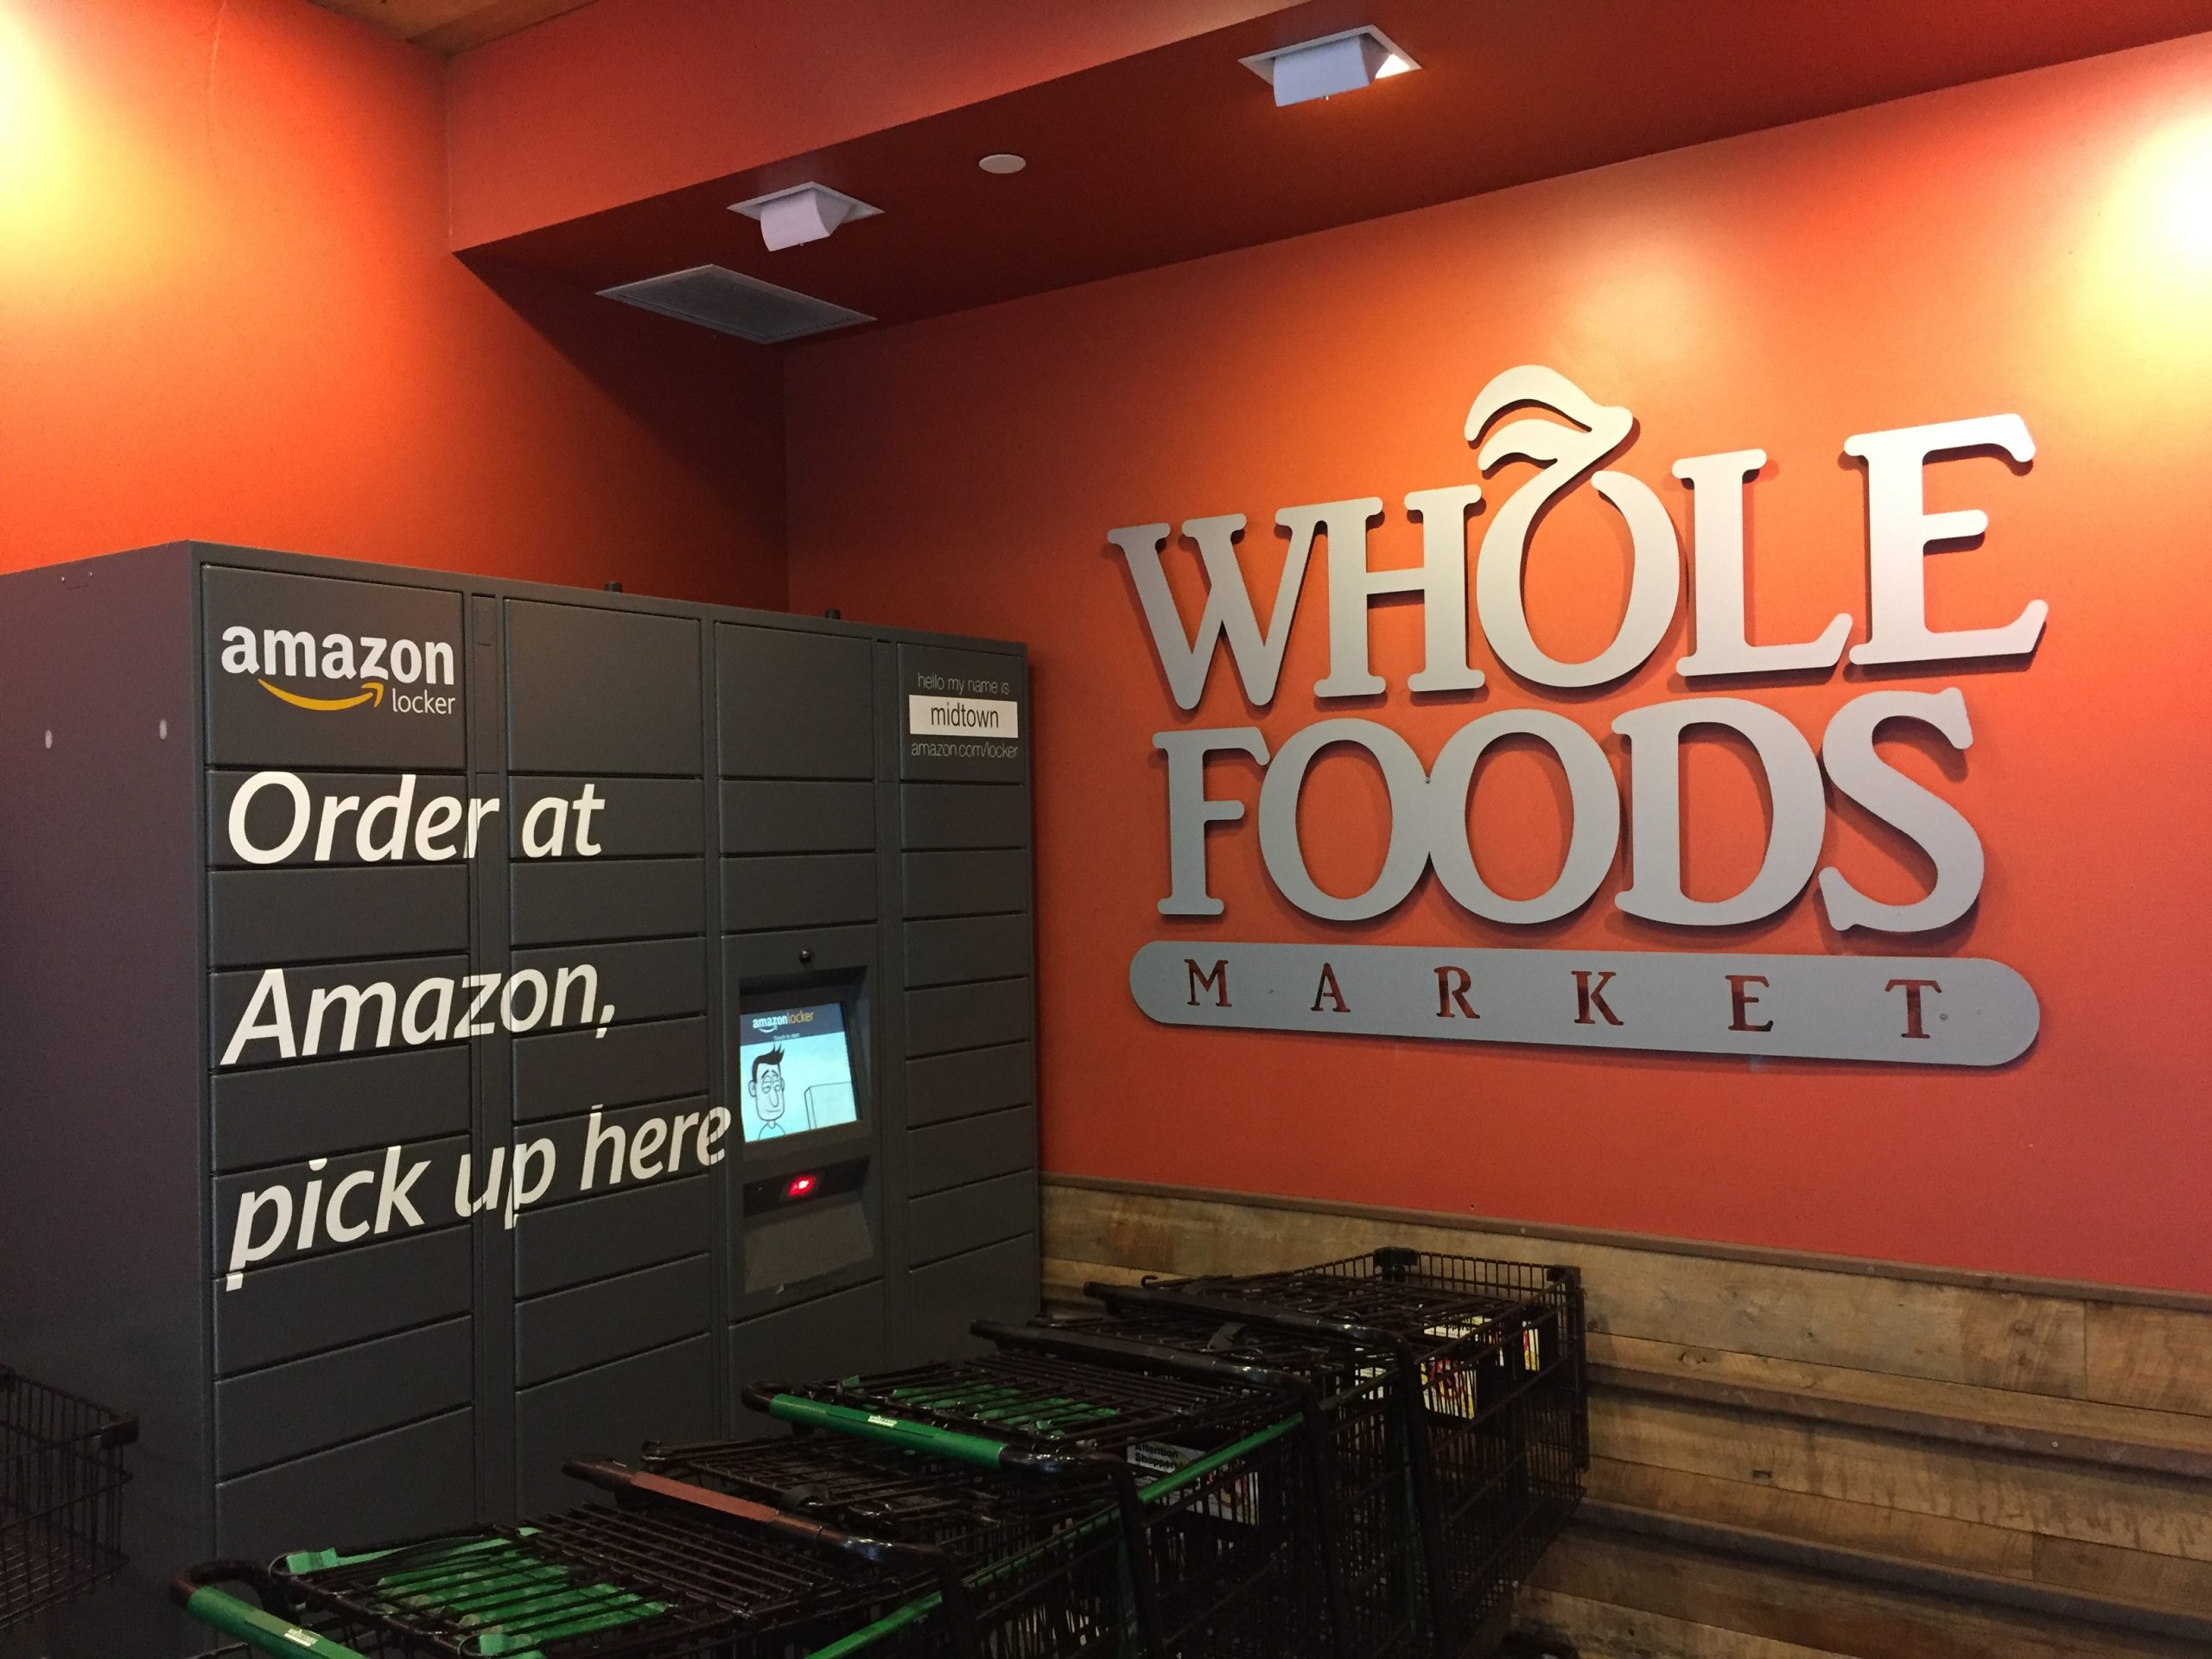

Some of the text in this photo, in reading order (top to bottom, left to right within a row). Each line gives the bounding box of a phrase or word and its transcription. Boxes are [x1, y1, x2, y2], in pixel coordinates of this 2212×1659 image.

[1108, 365, 2049, 710] WHOLE
[220, 626, 454, 685] amazon
[918, 672, 1010, 695] hello my name is
[391, 688, 455, 715] locker
[931, 702, 999, 728] midtown
[228, 771, 606, 864] Order at
[1152, 687, 1986, 933] FOODS
[219, 963, 615, 1066] Amazon,
[1184, 958, 1942, 1039] MARKET
[226, 1103, 731, 1291] pick up here
